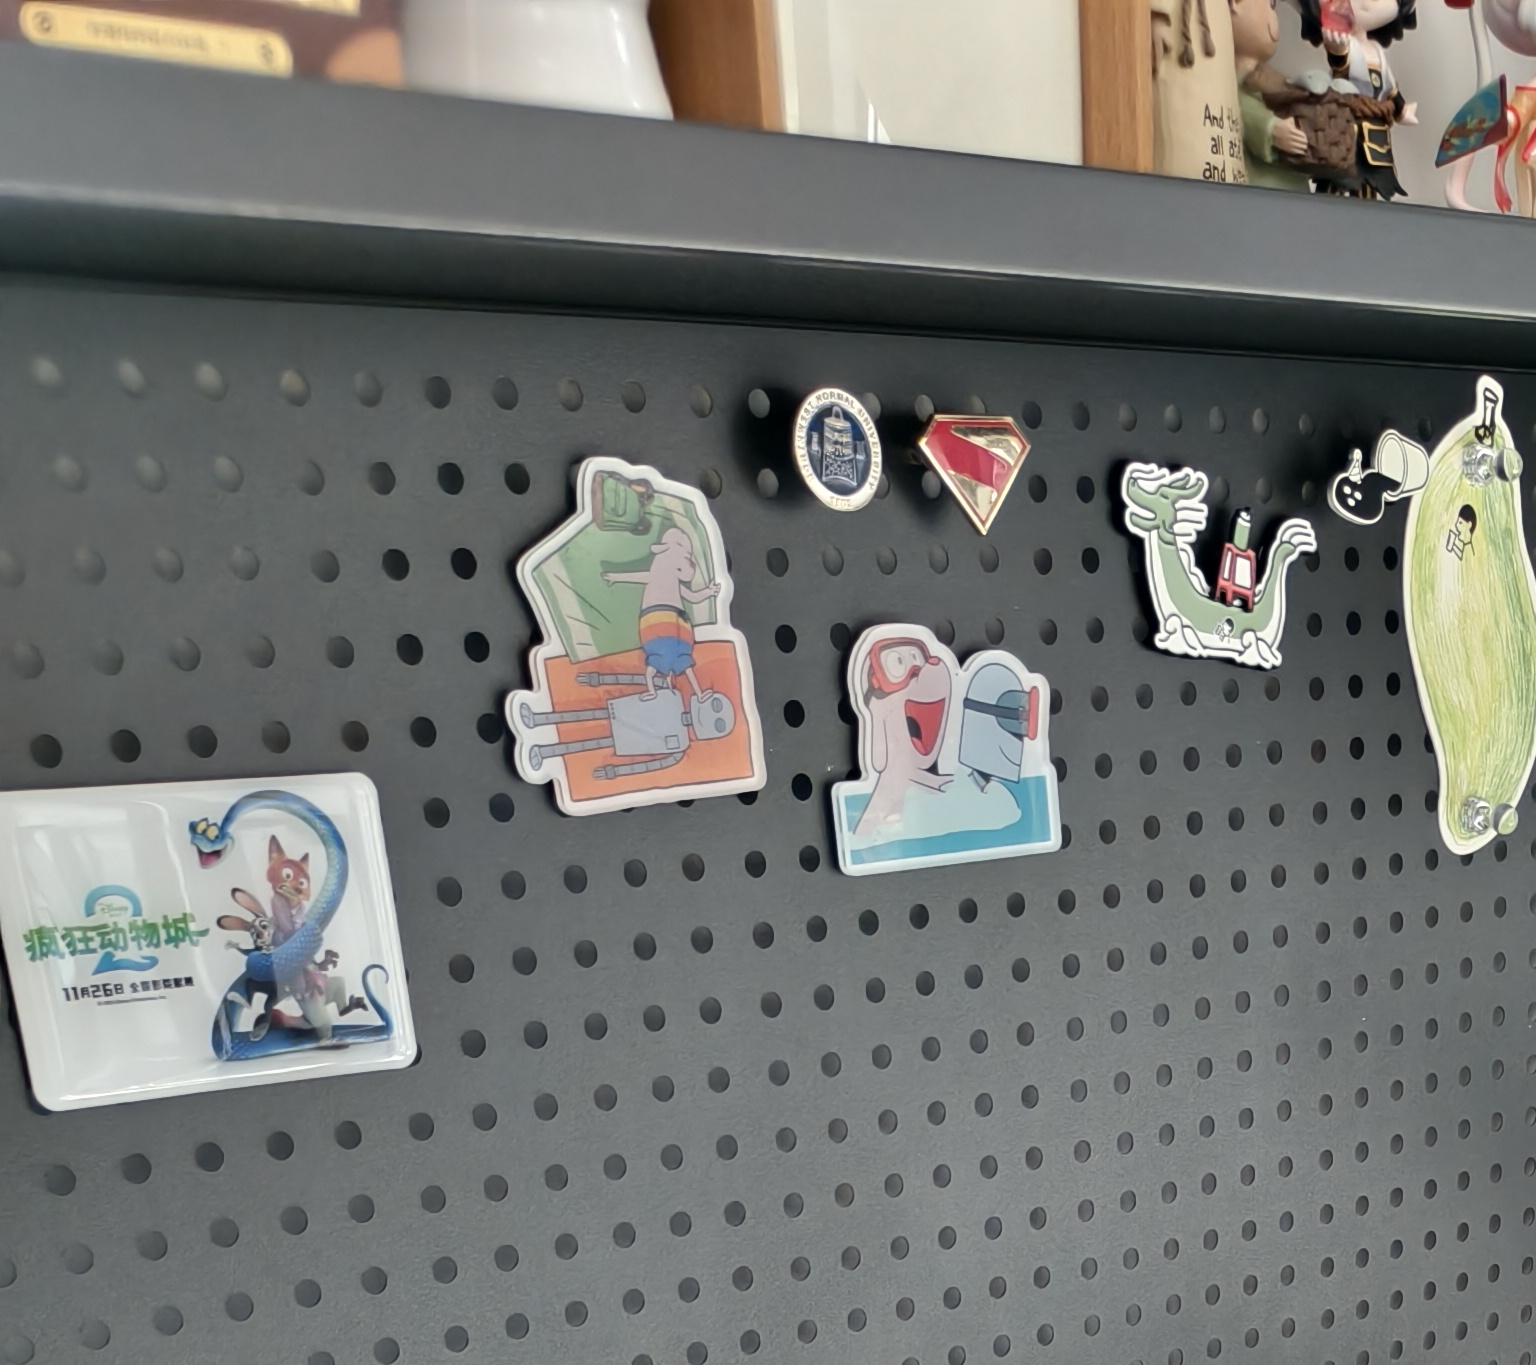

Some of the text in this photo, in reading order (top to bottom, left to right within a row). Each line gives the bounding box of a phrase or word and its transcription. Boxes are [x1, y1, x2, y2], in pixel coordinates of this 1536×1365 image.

[1203, 103, 1224, 129] And
[1211, 135, 1224, 155] all
[1203, 160, 1226, 182] and
[815, 390, 856, 412] NORMAL
[22, 912, 210, 963] 疯狂动物城
[62, 983, 125, 1002] 11月26日
